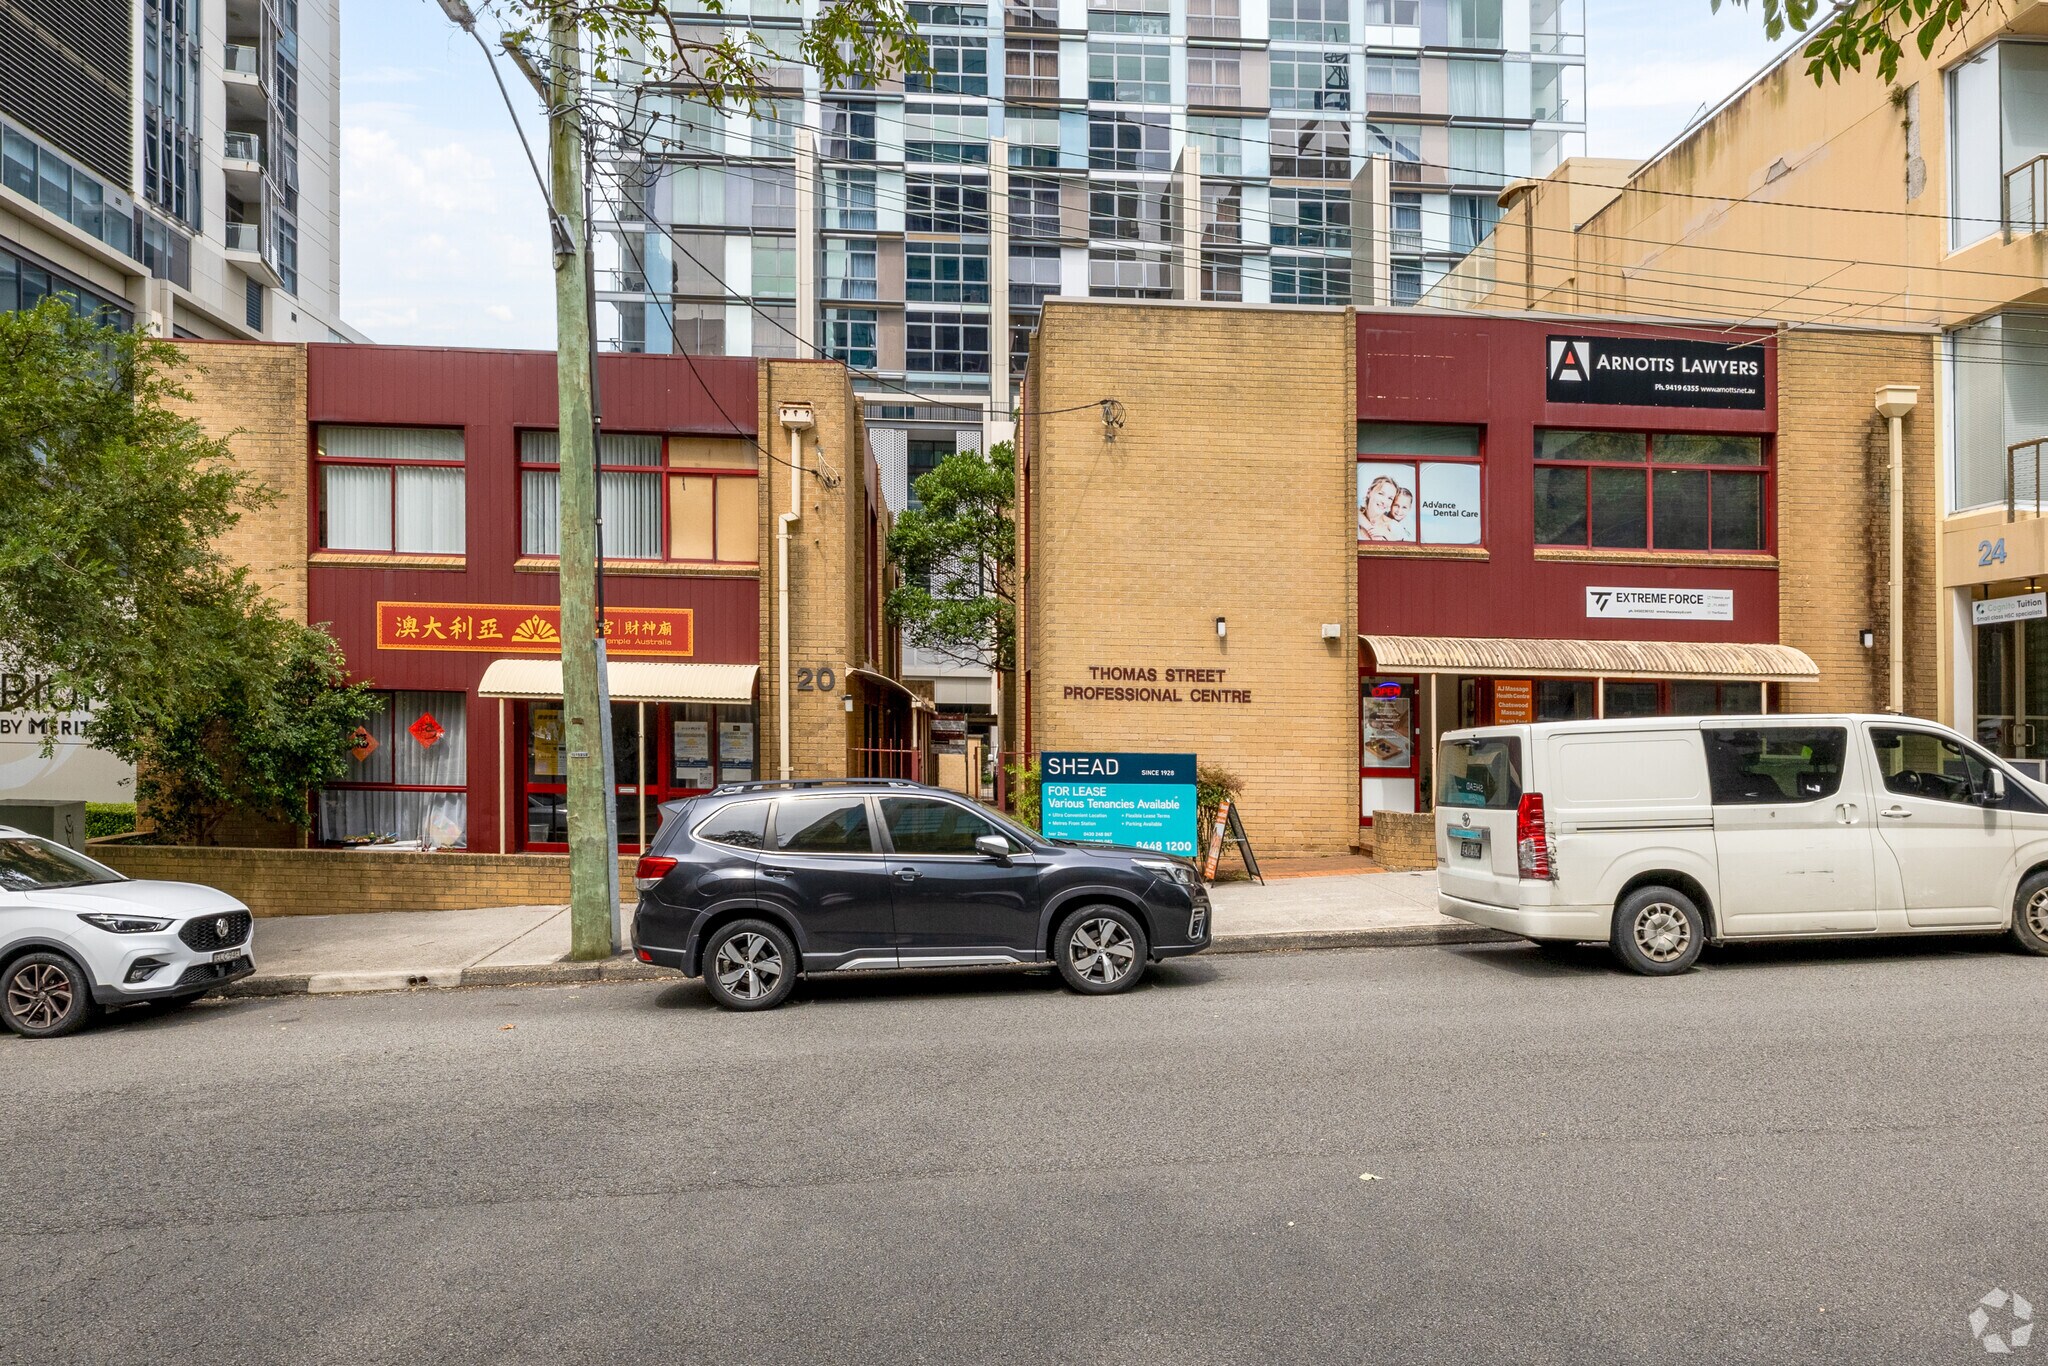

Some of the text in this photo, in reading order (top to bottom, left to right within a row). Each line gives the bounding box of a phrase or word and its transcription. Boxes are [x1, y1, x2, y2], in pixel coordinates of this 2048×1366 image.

[1596, 353, 1758, 375] ARNOTTS LAWYERS
[1422, 501, 1456, 509] Advance
[1433, 509, 1479, 518] Dental Care
[1978, 537, 2008, 567] 24
[1616, 592, 1704, 605] EXTREME FORCE
[1987, 599, 2042, 612] Cognito Tuition
[1976, 614, 1990, 622] Small
[2015, 609, 2043, 619] specialists
[395, 614, 503, 641] 澳大利亞
[624, 619, 672, 636] 財神廟
[634, 638, 672, 646] Australia
[797, 667, 836, 692] 20
[1089, 666, 1226, 683] THOMAS STREET
[1063, 686, 1252, 704] PROFESSIONAL CENTRE
[1371, 686, 1401, 697] OPEN
[1, 719, 22, 734] BY
[1048, 757, 1119, 776] SHEAD
[1048, 786, 1107, 797] FOR LEASE
[1048, 798, 1180, 810] Various Tenancies Available
[1136, 841, 1192, 851] 8448 1200
